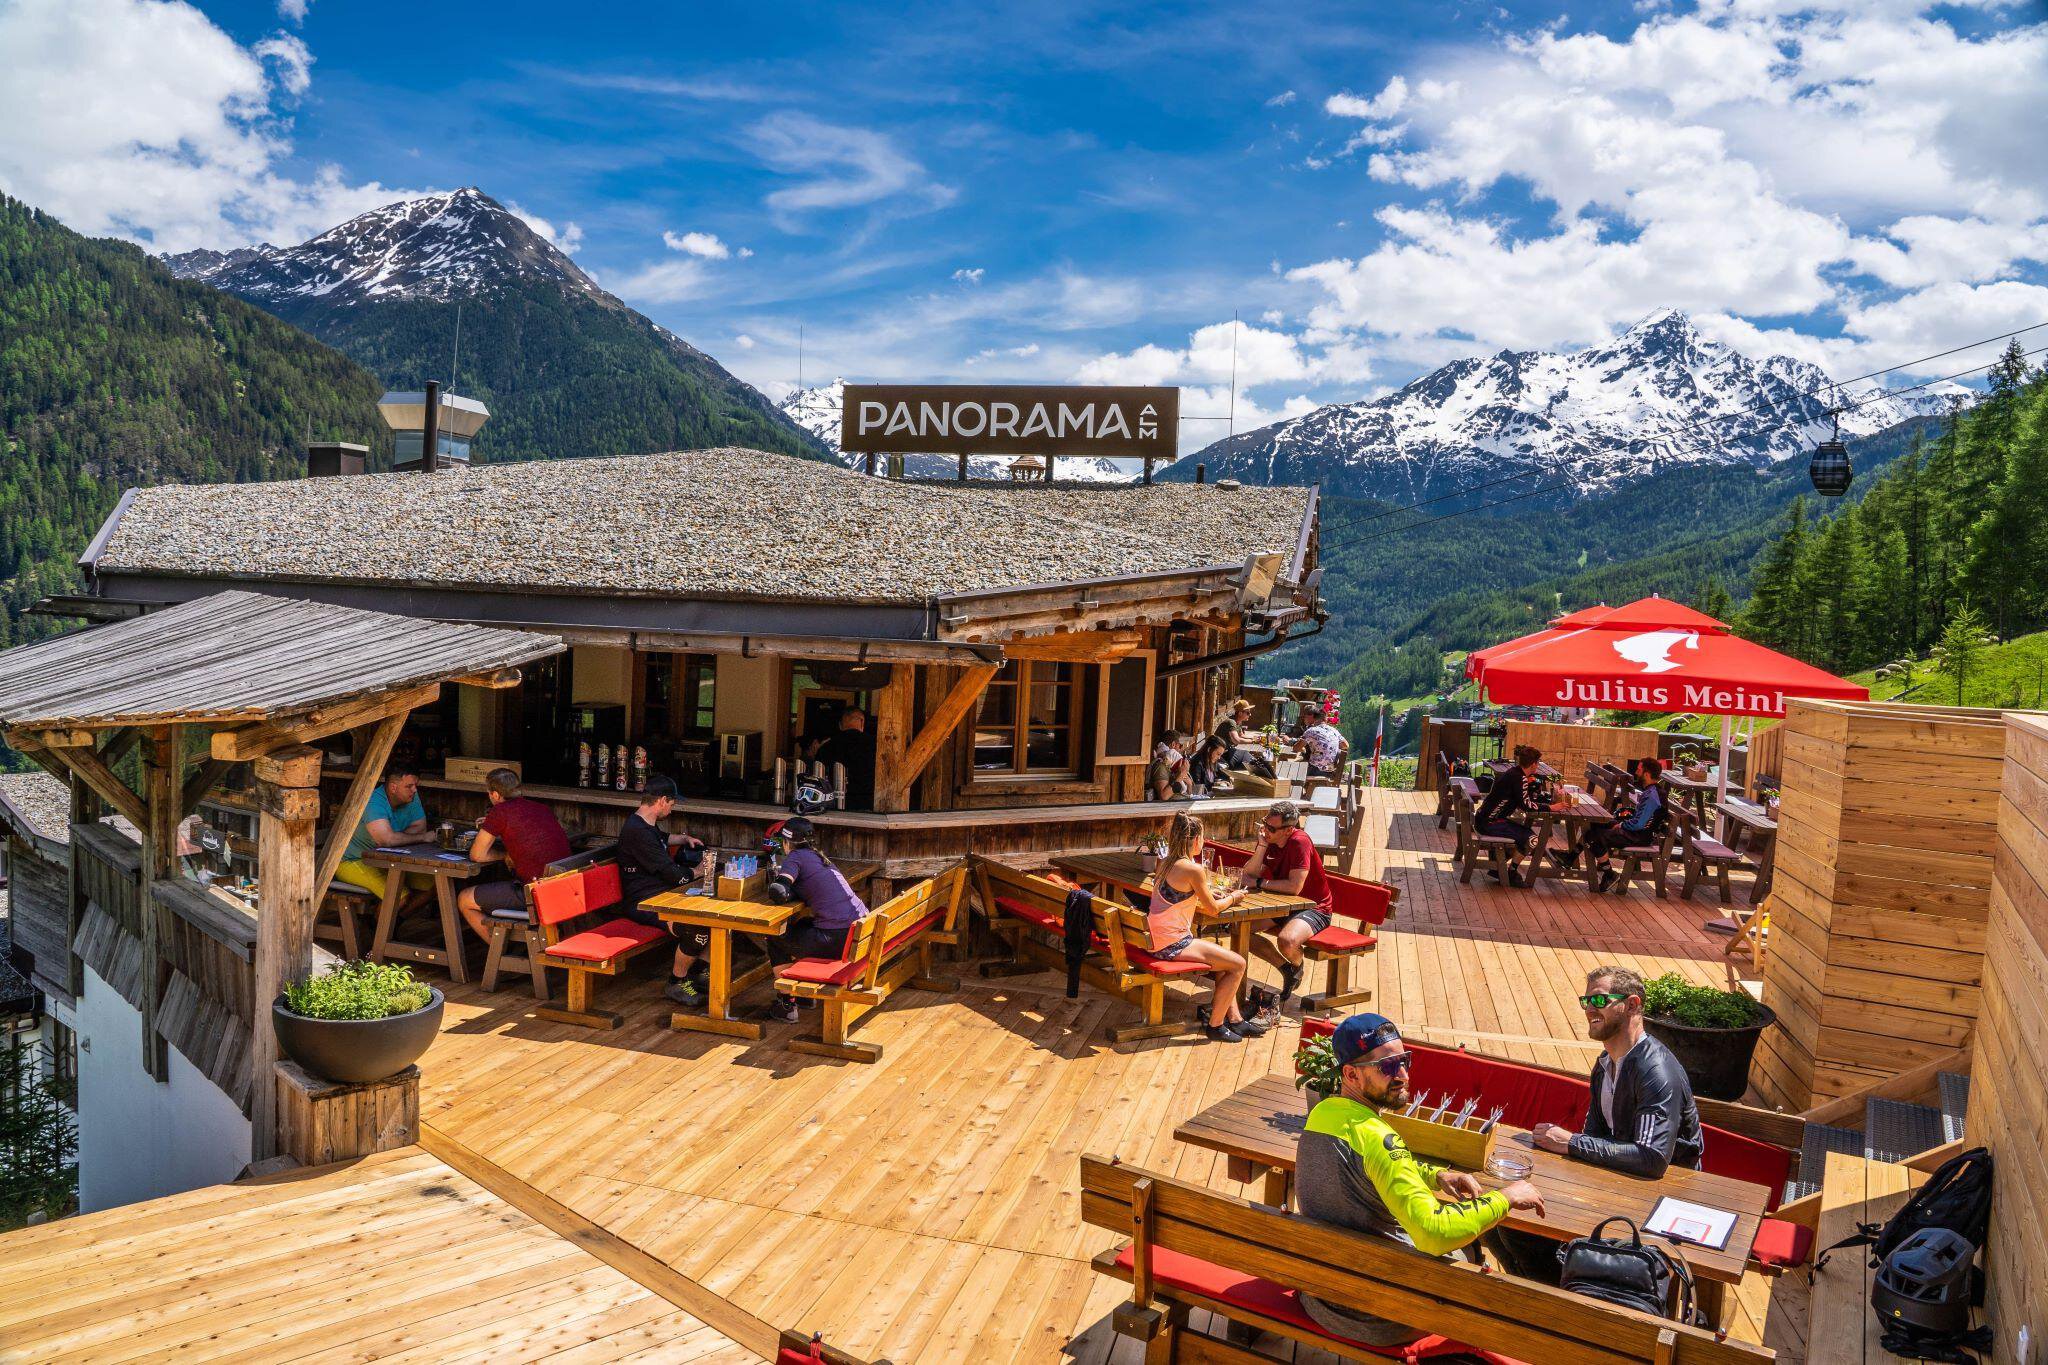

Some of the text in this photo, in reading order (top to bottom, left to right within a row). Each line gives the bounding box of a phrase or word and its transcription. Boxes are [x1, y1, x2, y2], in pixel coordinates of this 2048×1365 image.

[858, 401, 1132, 439] PANORAMA
[1138, 403, 1158, 440] ALM
[1556, 678, 1785, 714] Julius Meinl
